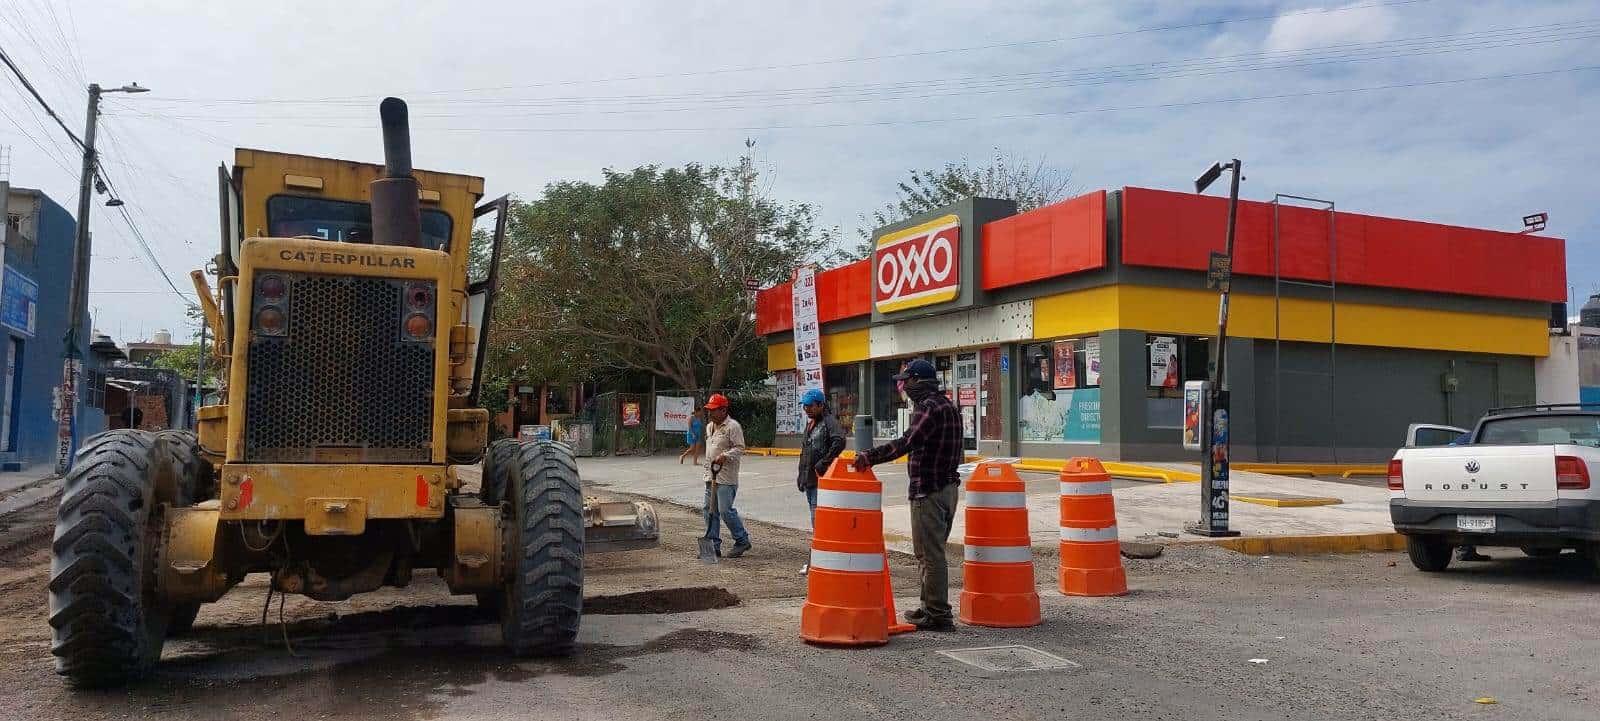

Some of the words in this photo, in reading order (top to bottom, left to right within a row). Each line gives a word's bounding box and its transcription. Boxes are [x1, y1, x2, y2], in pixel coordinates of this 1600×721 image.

[279, 249, 416, 269] CATERPILLAR
[878, 232, 953, 298] OXXO
[1424, 483, 1529, 491] ROBUST
